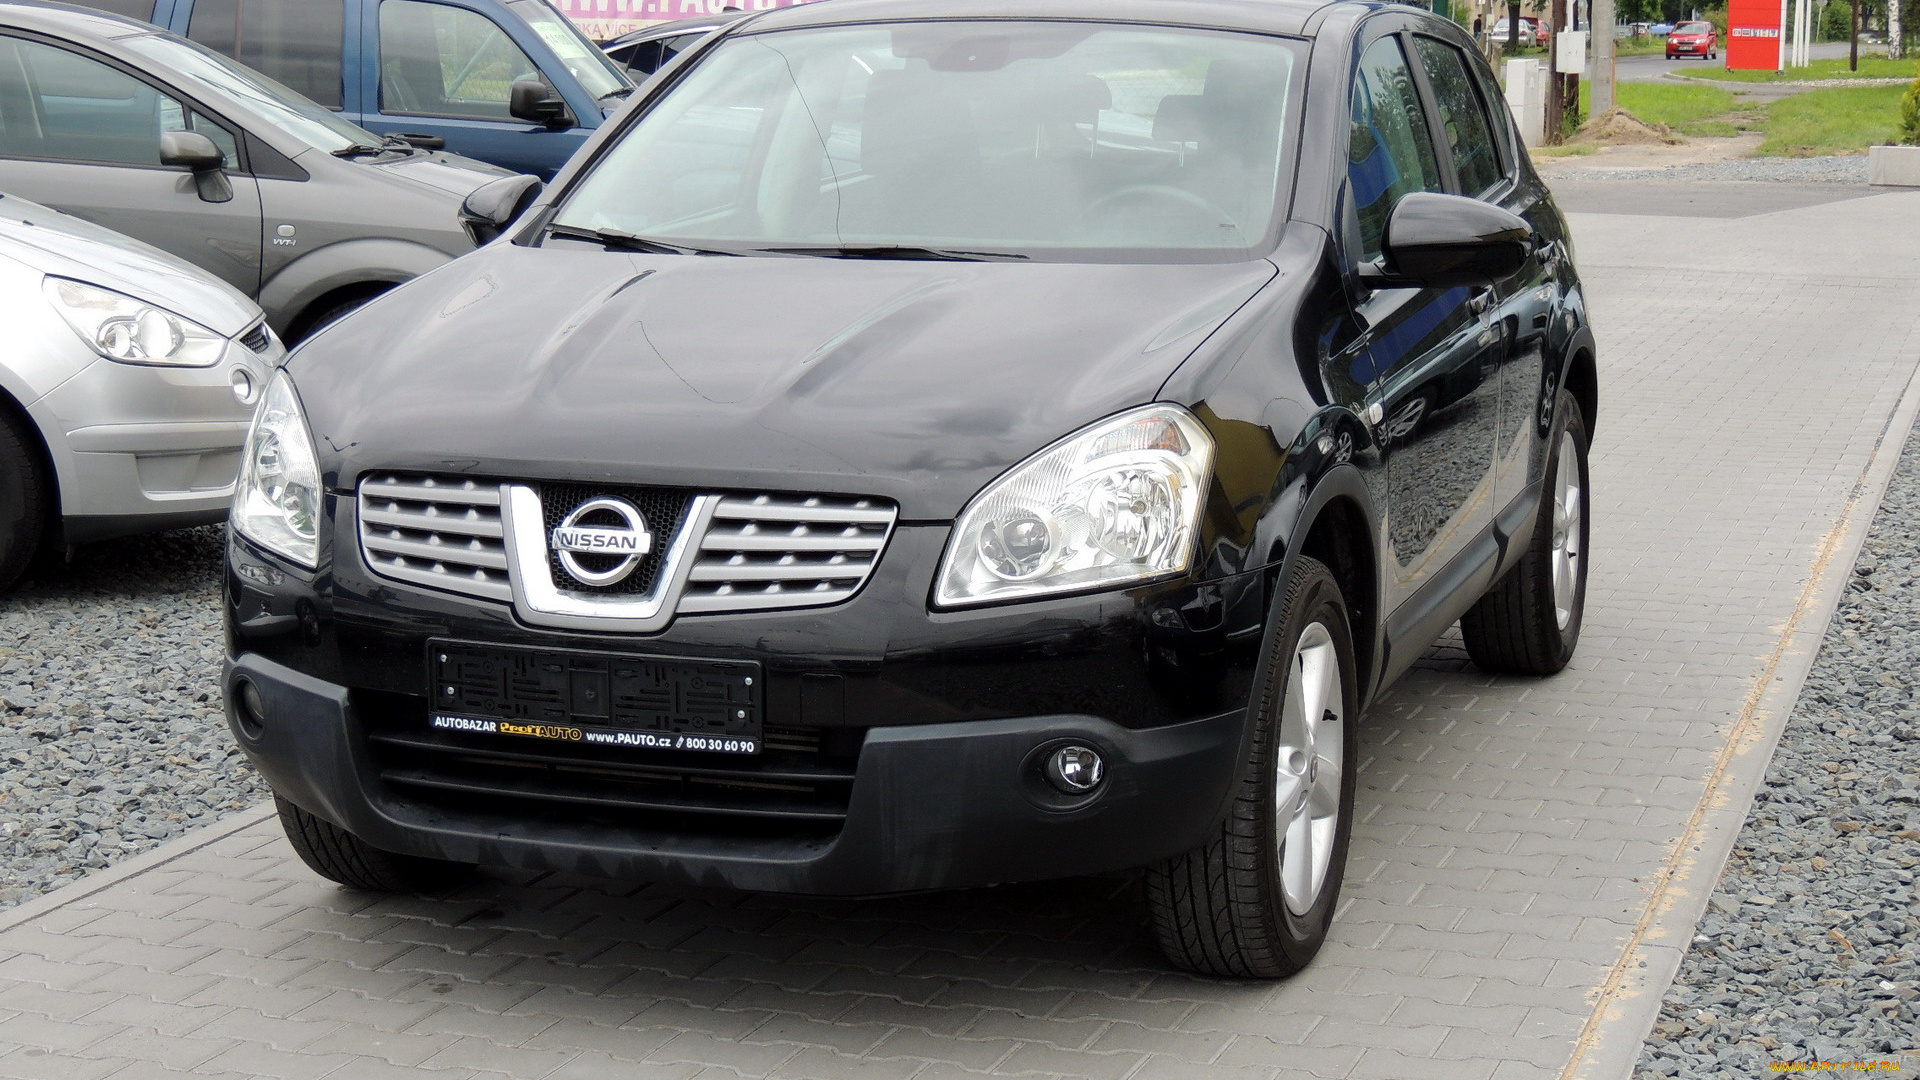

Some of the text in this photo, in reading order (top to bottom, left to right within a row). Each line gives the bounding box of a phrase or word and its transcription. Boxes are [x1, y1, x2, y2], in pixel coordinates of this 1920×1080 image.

[560, 532, 637, 549] NISSAN
[434, 716, 497, 732] AUTOBAZAR
[586, 732, 672, 747] www.PAUTO.cz
[686, 737, 707, 749] 800
[708, 739, 723, 750] 30
[724, 740, 738, 751] 60
[740, 741, 754, 753] 90
